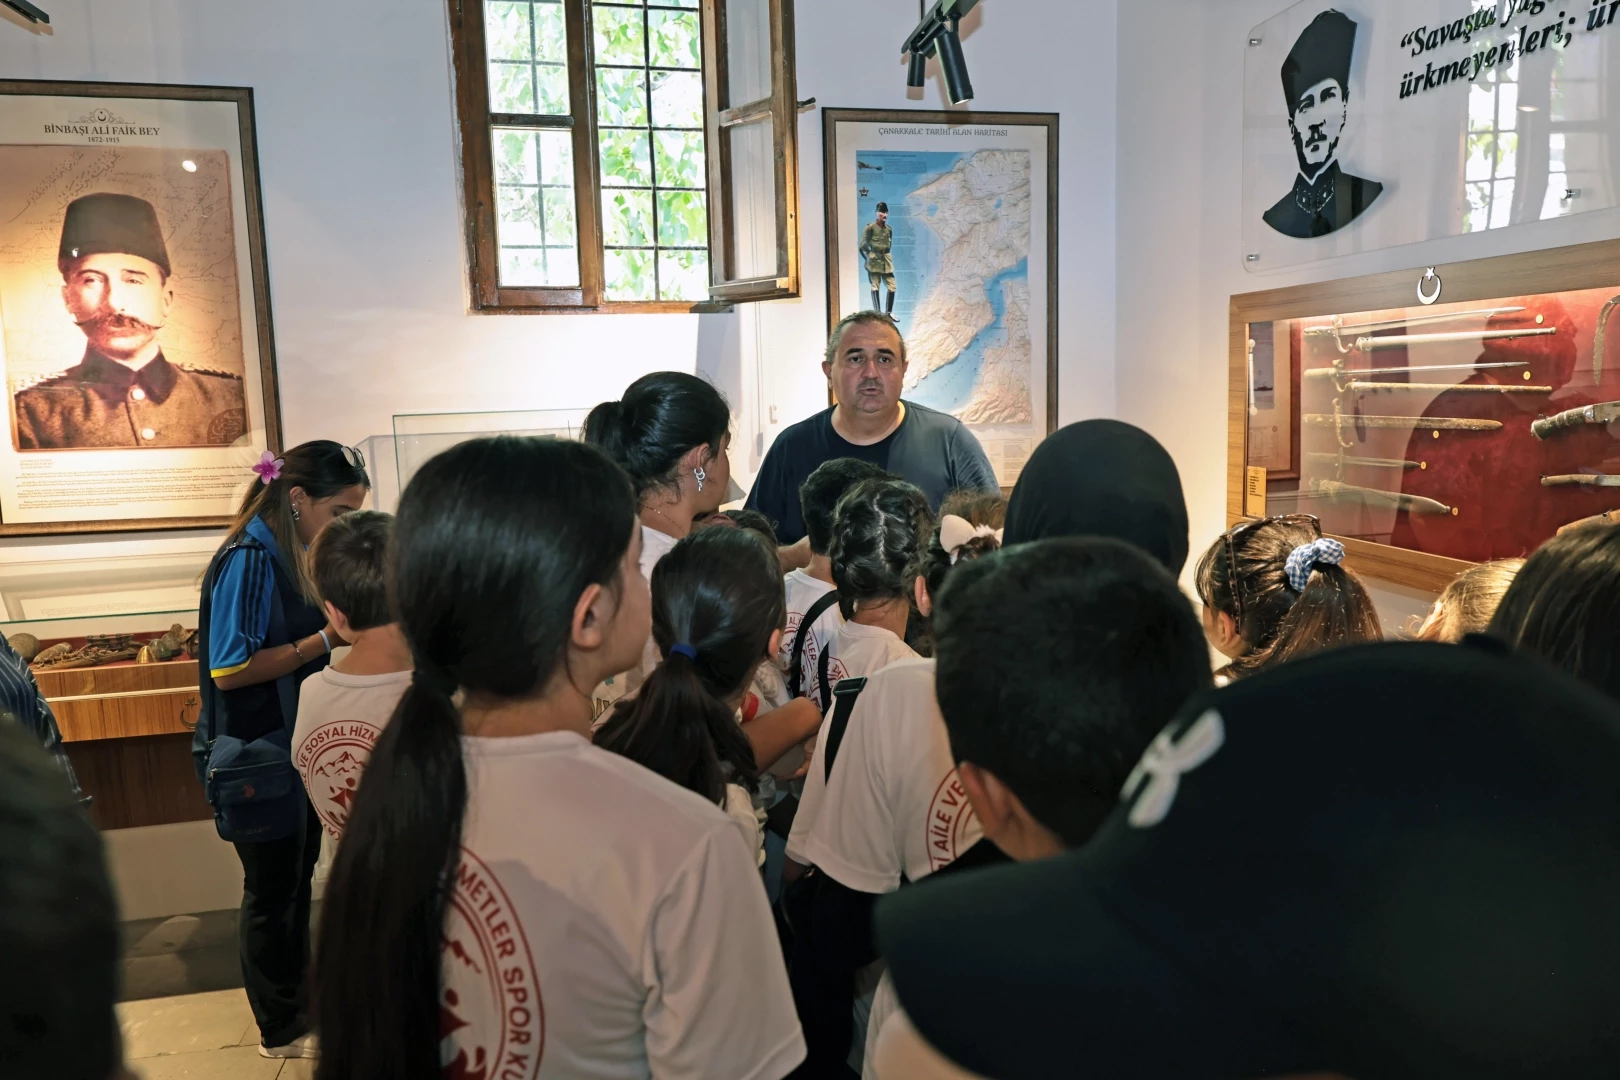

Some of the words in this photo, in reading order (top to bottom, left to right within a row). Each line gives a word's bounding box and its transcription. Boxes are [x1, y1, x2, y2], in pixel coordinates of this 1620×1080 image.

[1399, 11, 1576, 99] ürkmeyenleri;
[44, 123, 89, 136] BİNBAŞI
[91, 125, 110, 135] ALİ
[112, 125, 137, 135] FAİK
[139, 127, 160, 136] BEY
[878, 127, 924, 136] ÇANAKKALE
[925, 127, 951, 136] TARİHİ
[952, 128, 972, 136] ALAN
[974, 128, 1008, 137] HARİTASI
[300, 753, 309, 768] VE
[305, 726, 346, 754] SOSYAL
[930, 810, 952, 852] AİLE
[941, 780, 965, 807] VE
[503, 966, 531, 1045] SPOR
